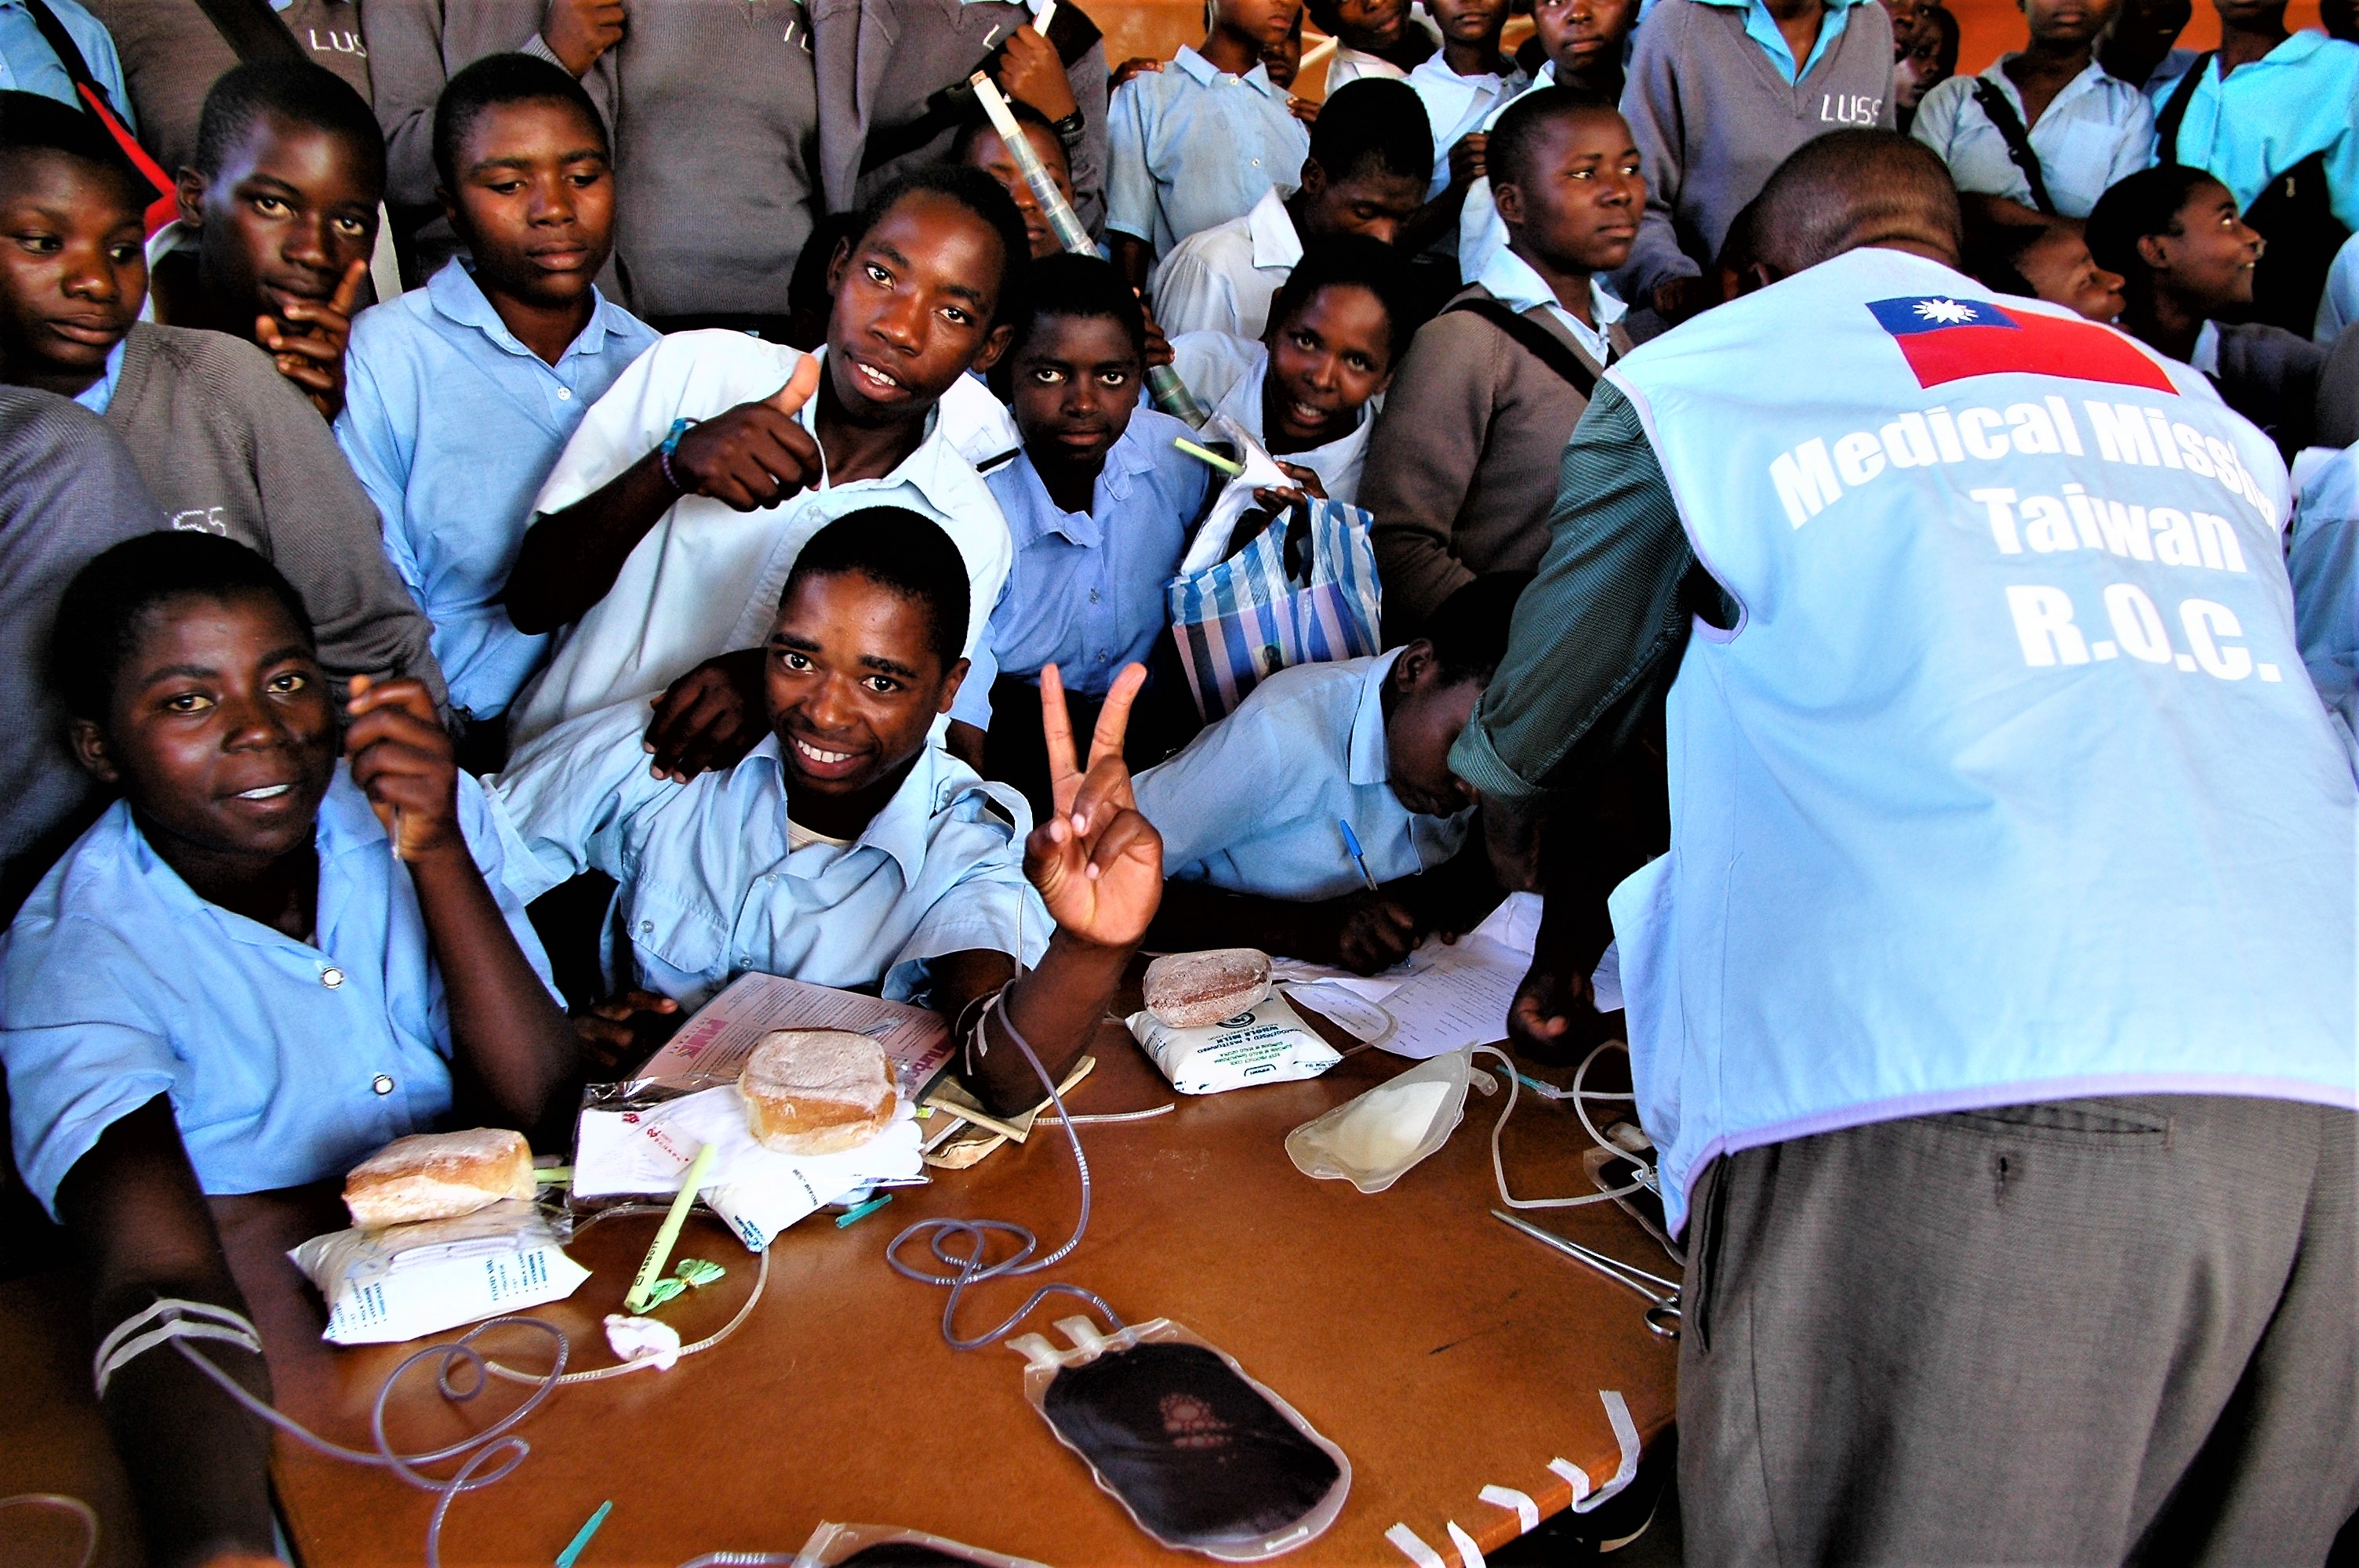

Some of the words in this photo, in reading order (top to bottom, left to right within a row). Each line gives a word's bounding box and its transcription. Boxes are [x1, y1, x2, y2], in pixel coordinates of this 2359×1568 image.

[1769, 395, 2085, 532] Medical
[1969, 483, 2247, 573] Taiwan
[2005, 583, 2282, 683] R.O.C.
